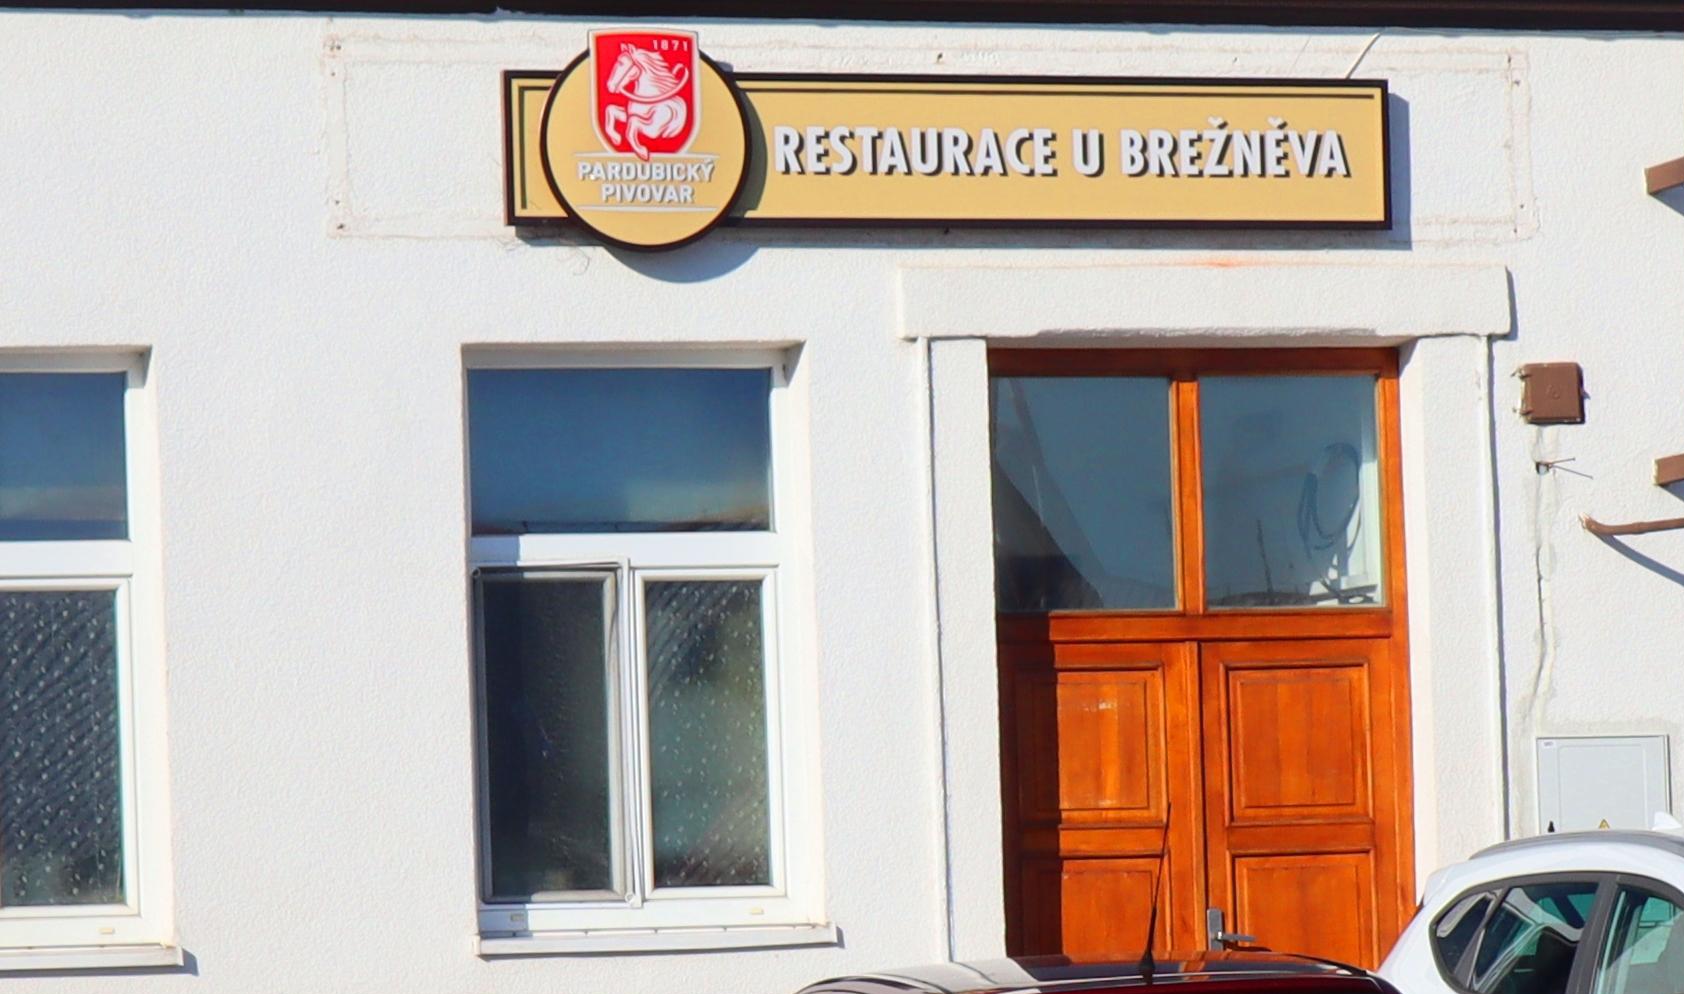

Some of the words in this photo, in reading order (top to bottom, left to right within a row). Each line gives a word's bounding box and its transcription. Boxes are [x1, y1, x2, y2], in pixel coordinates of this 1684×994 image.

[652, 39, 689, 52] 1871
[773, 125, 1056, 176] RESTAURACE
[1072, 128, 1104, 177] U
[1119, 115, 1351, 177] BREŽNĚVA
[577, 158, 716, 182] PARDUBICKÝ
[601, 183, 695, 203] PIVOVAR
